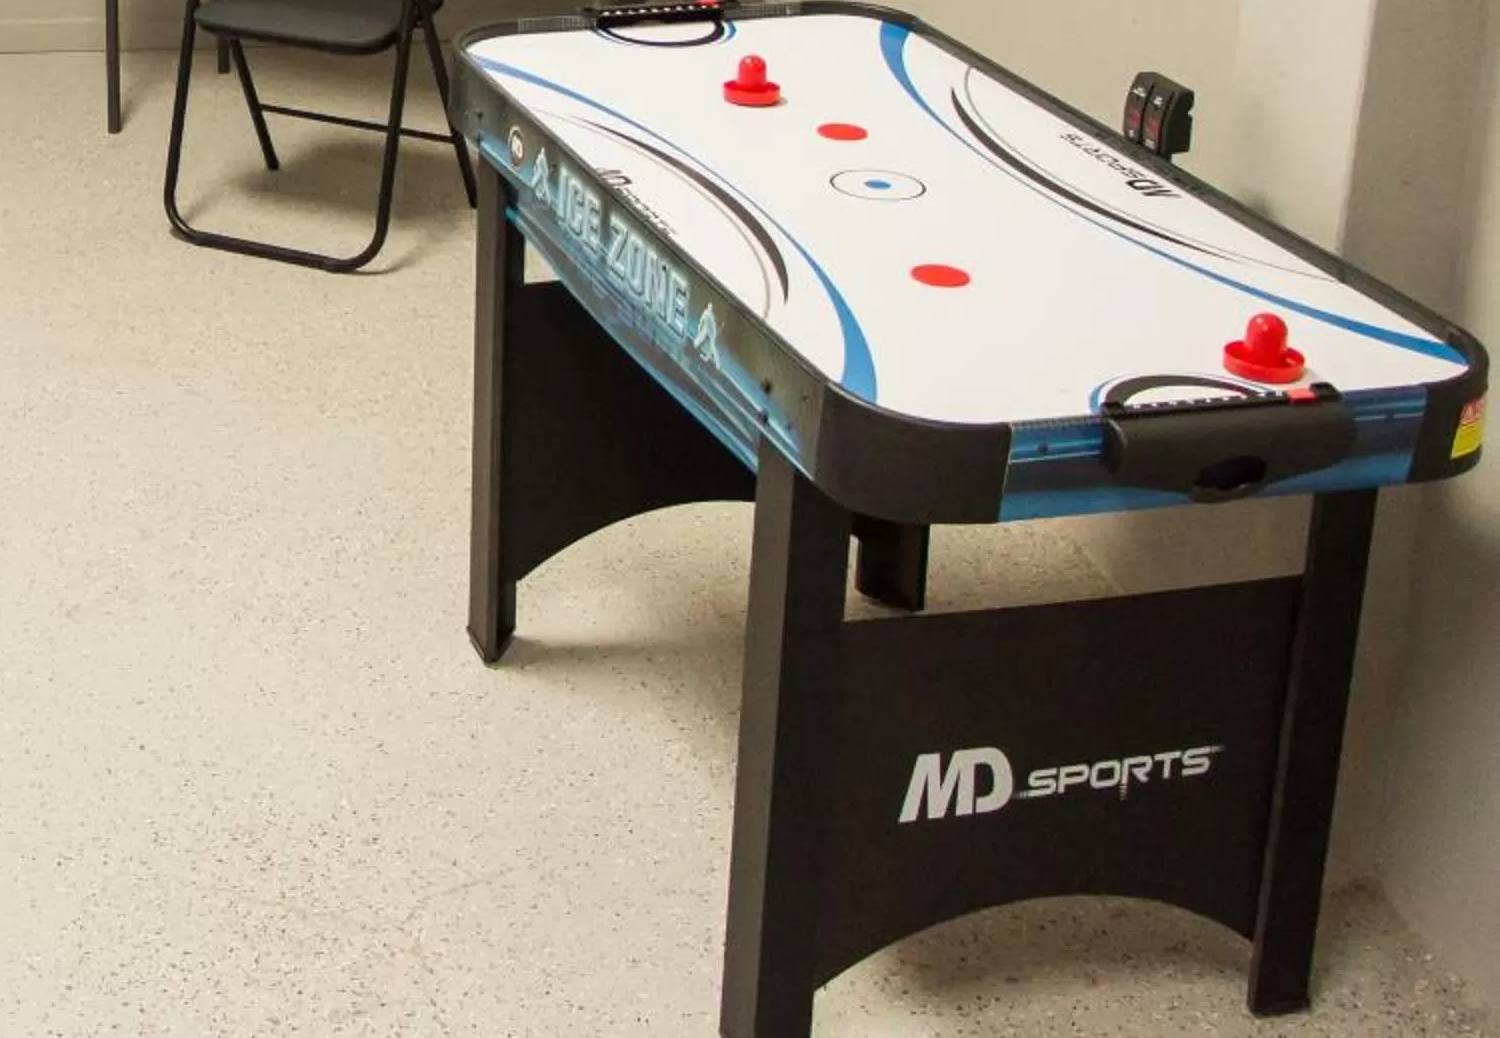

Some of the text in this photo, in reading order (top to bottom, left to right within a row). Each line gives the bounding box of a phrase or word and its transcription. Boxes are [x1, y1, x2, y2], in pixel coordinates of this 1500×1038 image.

[552, 165, 602, 255] ICE
[606, 214, 690, 340] ZONE
[898, 744, 1226, 824] MD SPORTS
